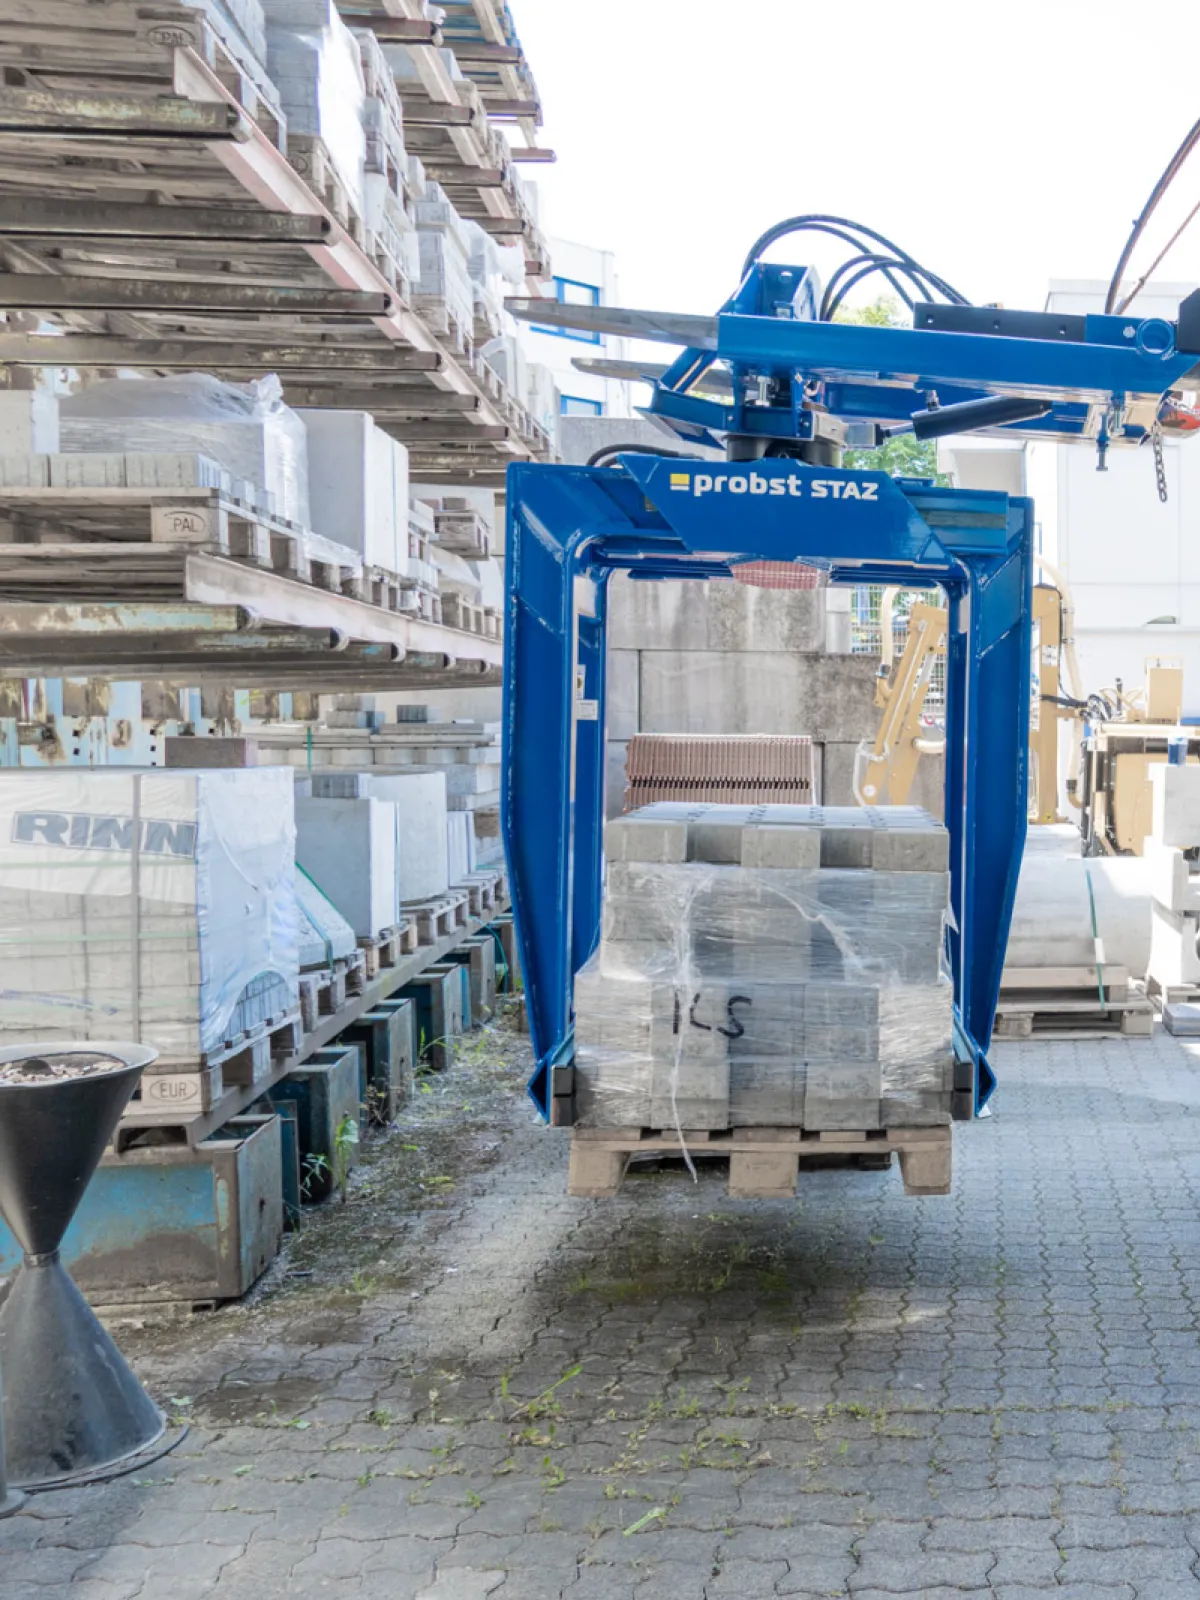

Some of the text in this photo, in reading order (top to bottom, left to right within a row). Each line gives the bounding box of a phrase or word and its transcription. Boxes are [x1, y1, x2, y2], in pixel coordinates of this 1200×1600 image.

[694, 472, 879, 501] probst STAZ
[16, 813, 195, 857] RINN
[160, 1082, 187, 1099] EUR
